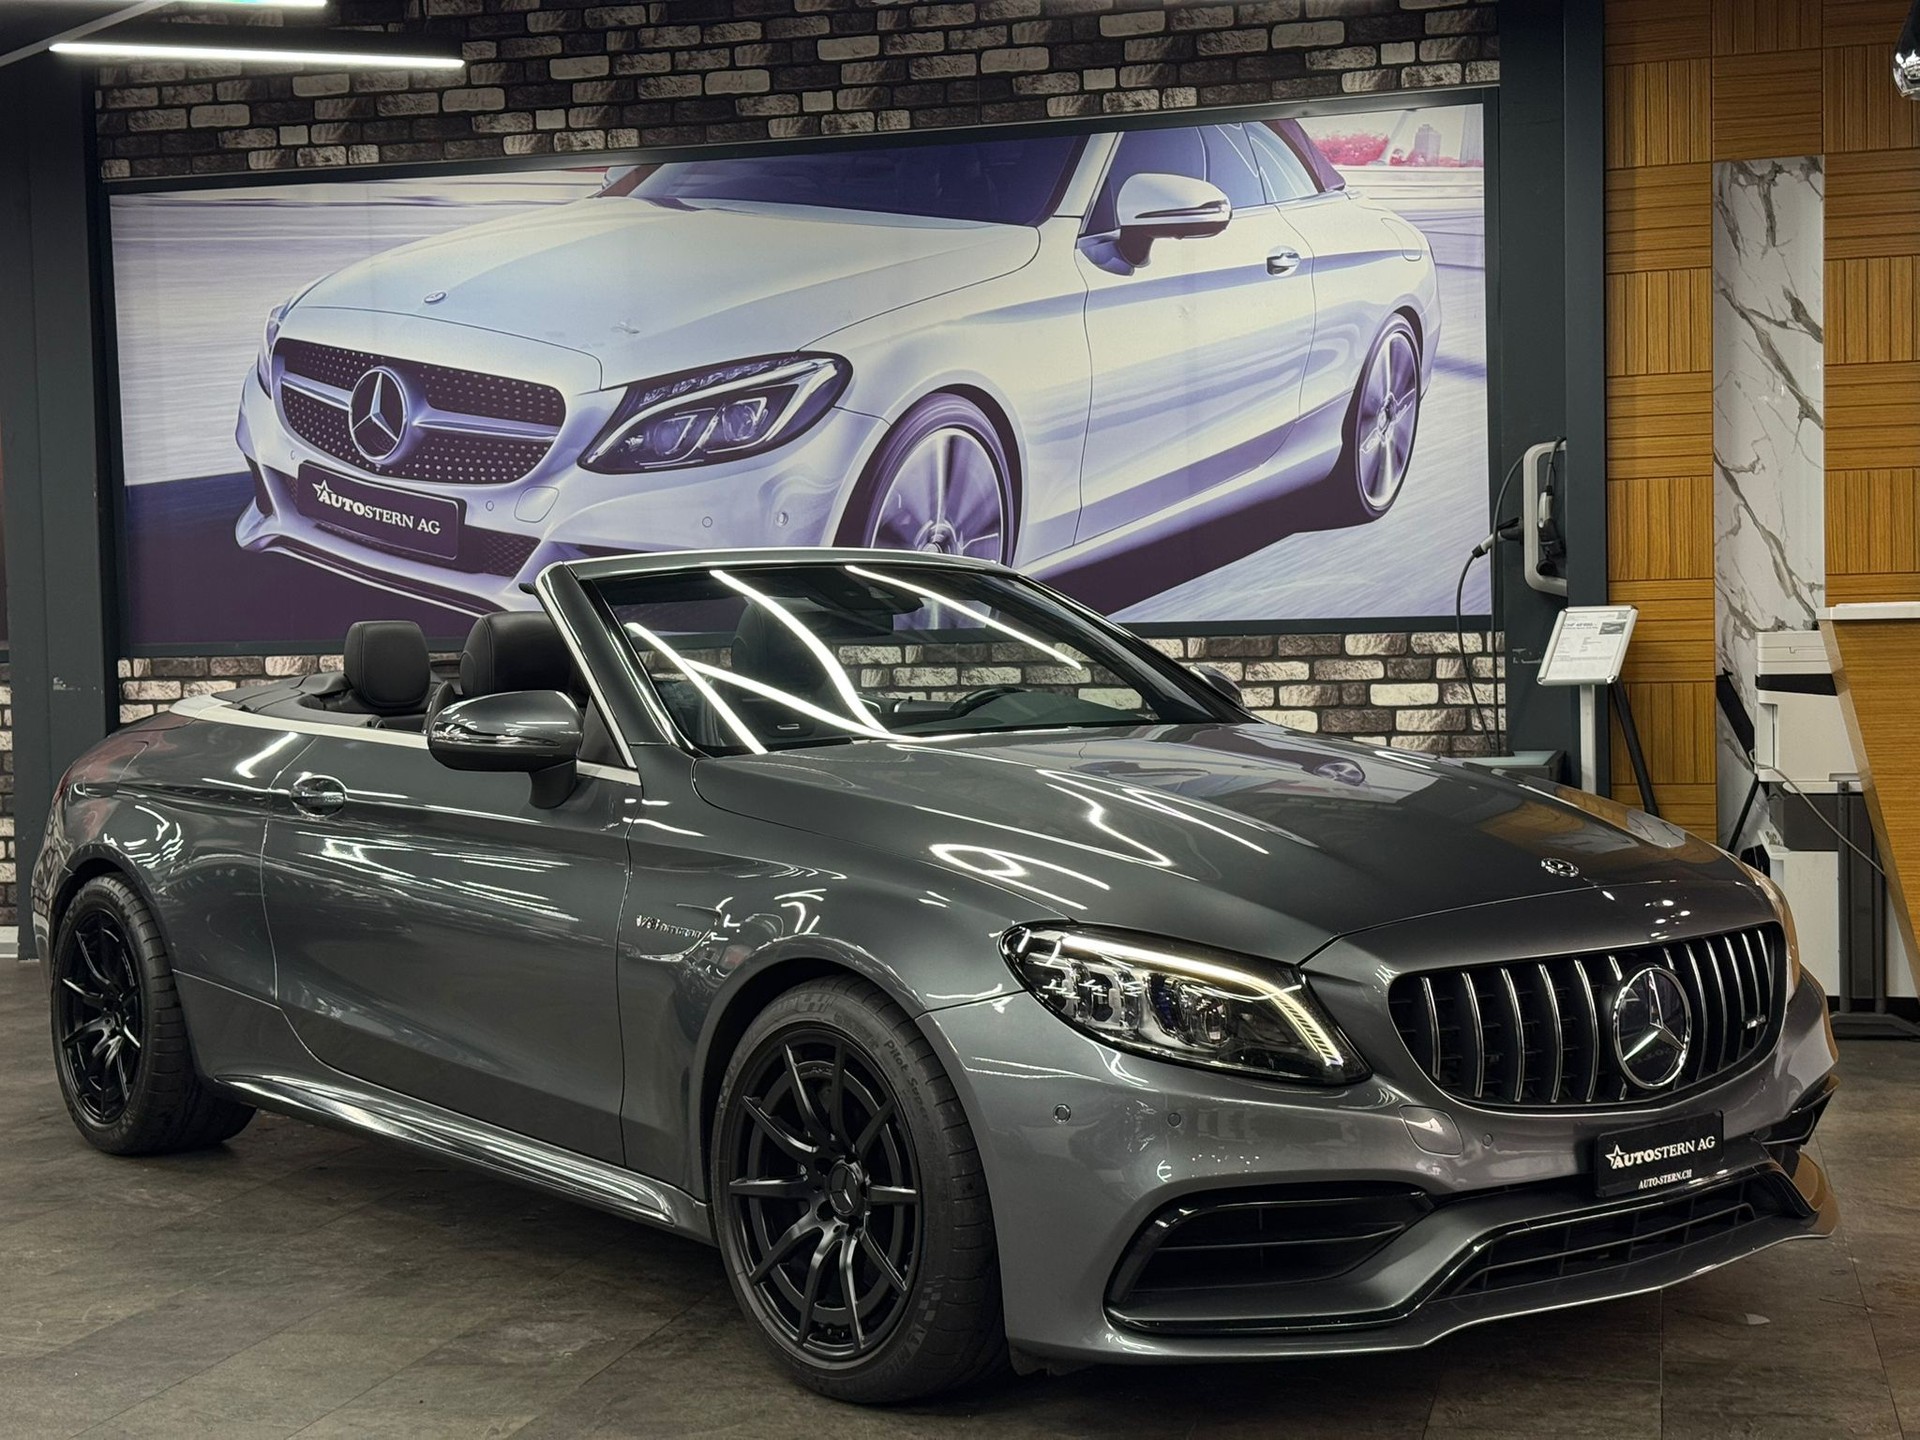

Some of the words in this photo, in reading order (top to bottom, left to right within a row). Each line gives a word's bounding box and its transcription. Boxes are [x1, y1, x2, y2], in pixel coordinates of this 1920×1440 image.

[317, 490, 415, 529] AUTOSTERN
[417, 518, 441, 535] AG
[884, 1039, 909, 1072] Pilot
[1611, 1140, 1695, 1169] AUTOSTERN
[1697, 1136, 1716, 1151] AG
